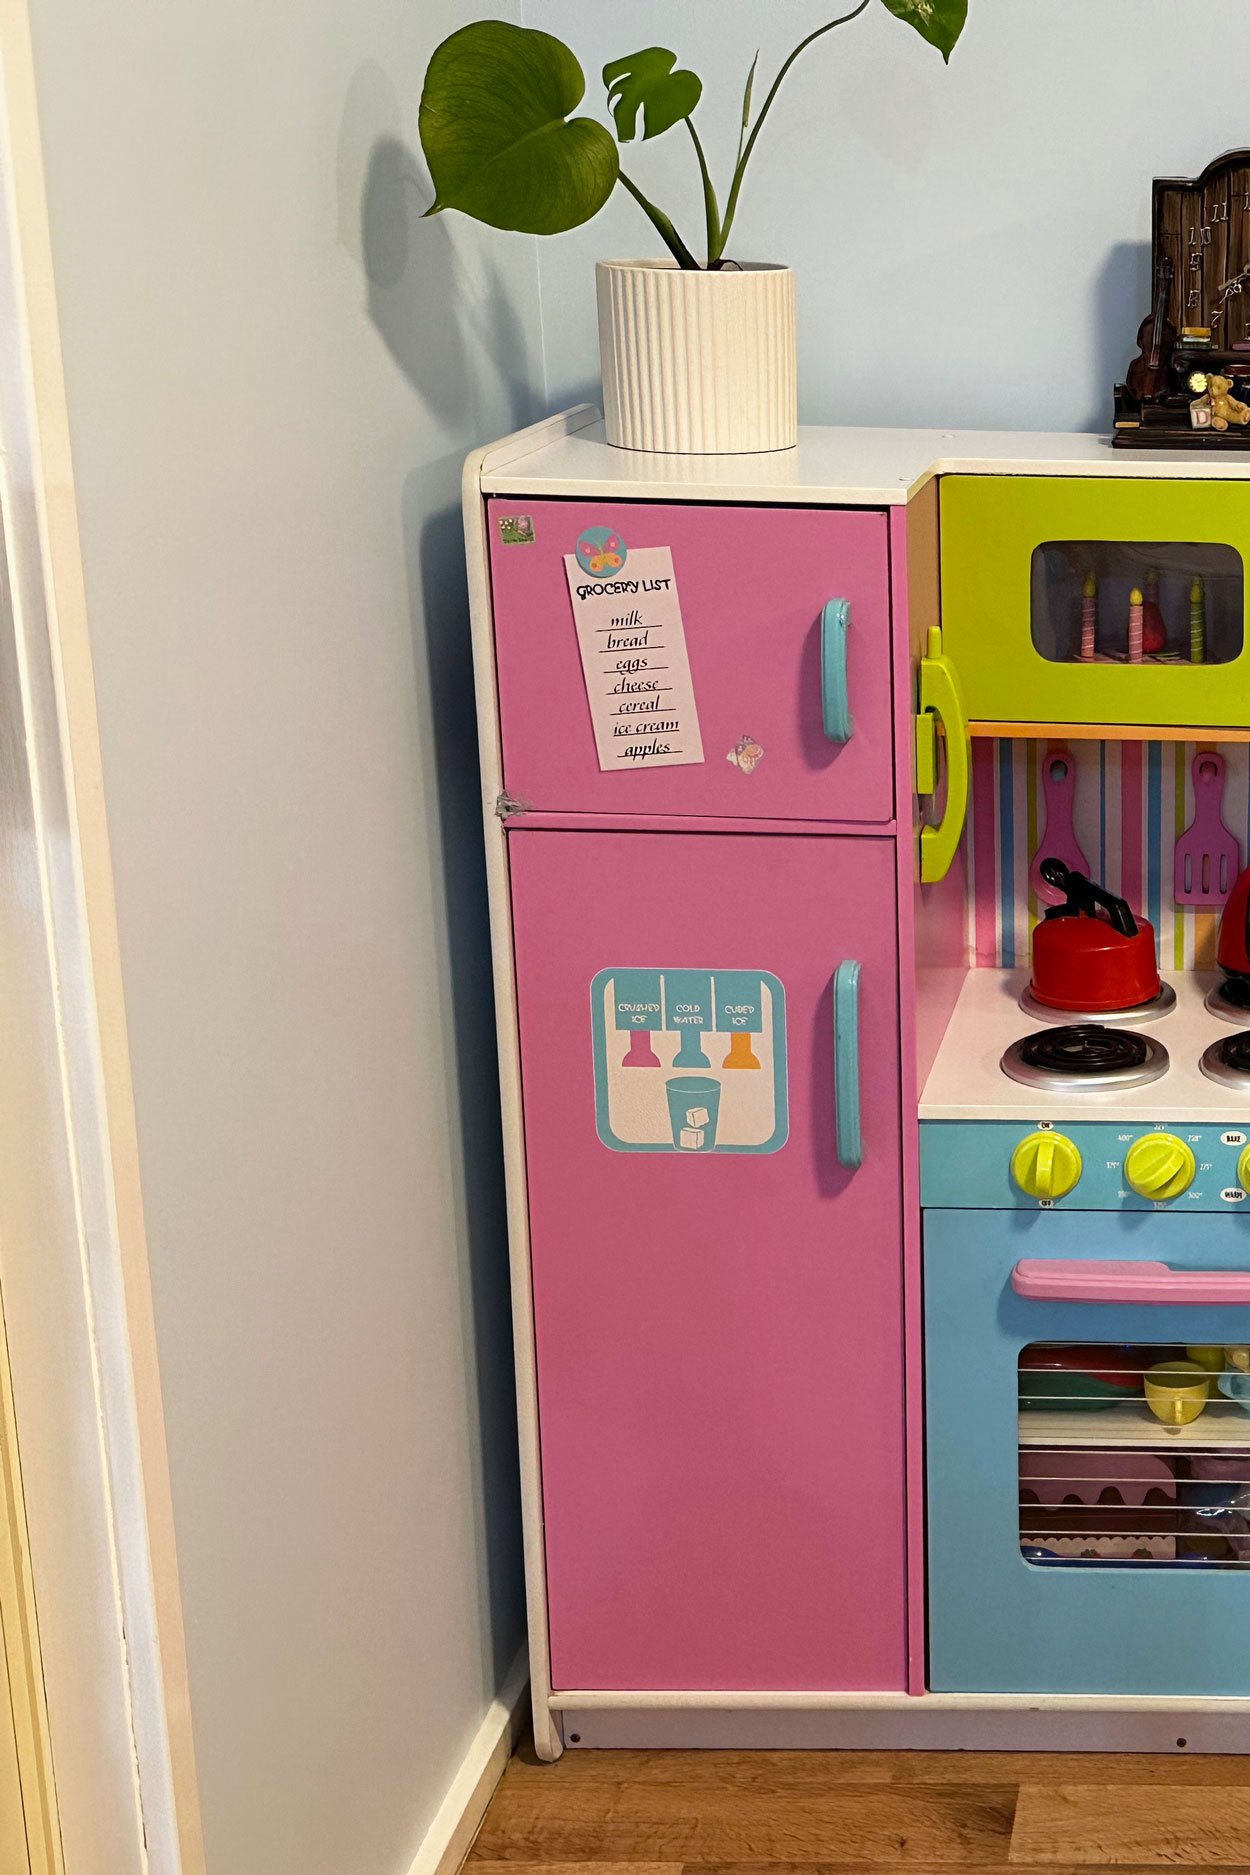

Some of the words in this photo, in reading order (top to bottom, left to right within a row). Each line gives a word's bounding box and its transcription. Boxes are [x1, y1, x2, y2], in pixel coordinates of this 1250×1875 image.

[1211, 202, 1229, 222] 11
[1188, 226, 1211, 245] 10
[1211, 310, 1223, 329] 7
[576, 581, 639, 600] GROCERY
[642, 579, 671, 592] LIST
[611, 610, 643, 626] milk
[607, 630, 648, 649] bread
[616, 659, 648, 675] eggs
[613, 677, 659, 694] cheese
[619, 694, 660, 713] cereal
[613, 722, 632, 735] ice
[635, 721, 679, 733] cream
[624, 738, 670, 761] apples
[676, 1004, 700, 1013] COLD
[673, 1015, 703, 1025] WATER
